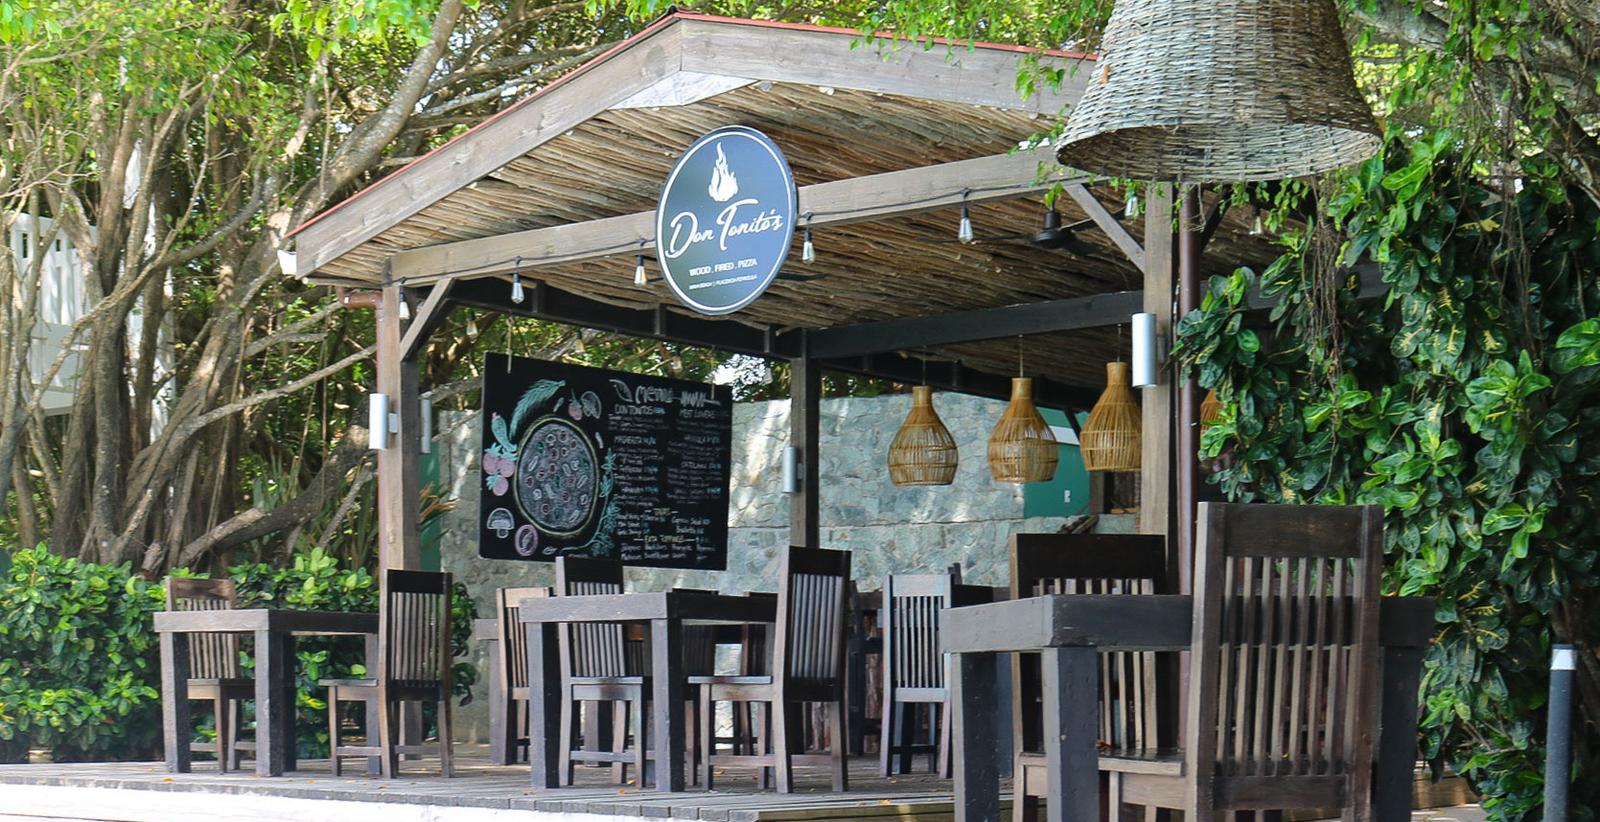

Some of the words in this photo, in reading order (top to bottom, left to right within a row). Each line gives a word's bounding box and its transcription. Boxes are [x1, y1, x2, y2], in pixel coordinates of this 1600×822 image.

[665, 211, 714, 259] Don
[716, 198, 783, 251] Tonito's
[689, 265, 712, 277] WOOD
[714, 262, 735, 273] FIRED
[737, 258, 758, 269] PIZZA
